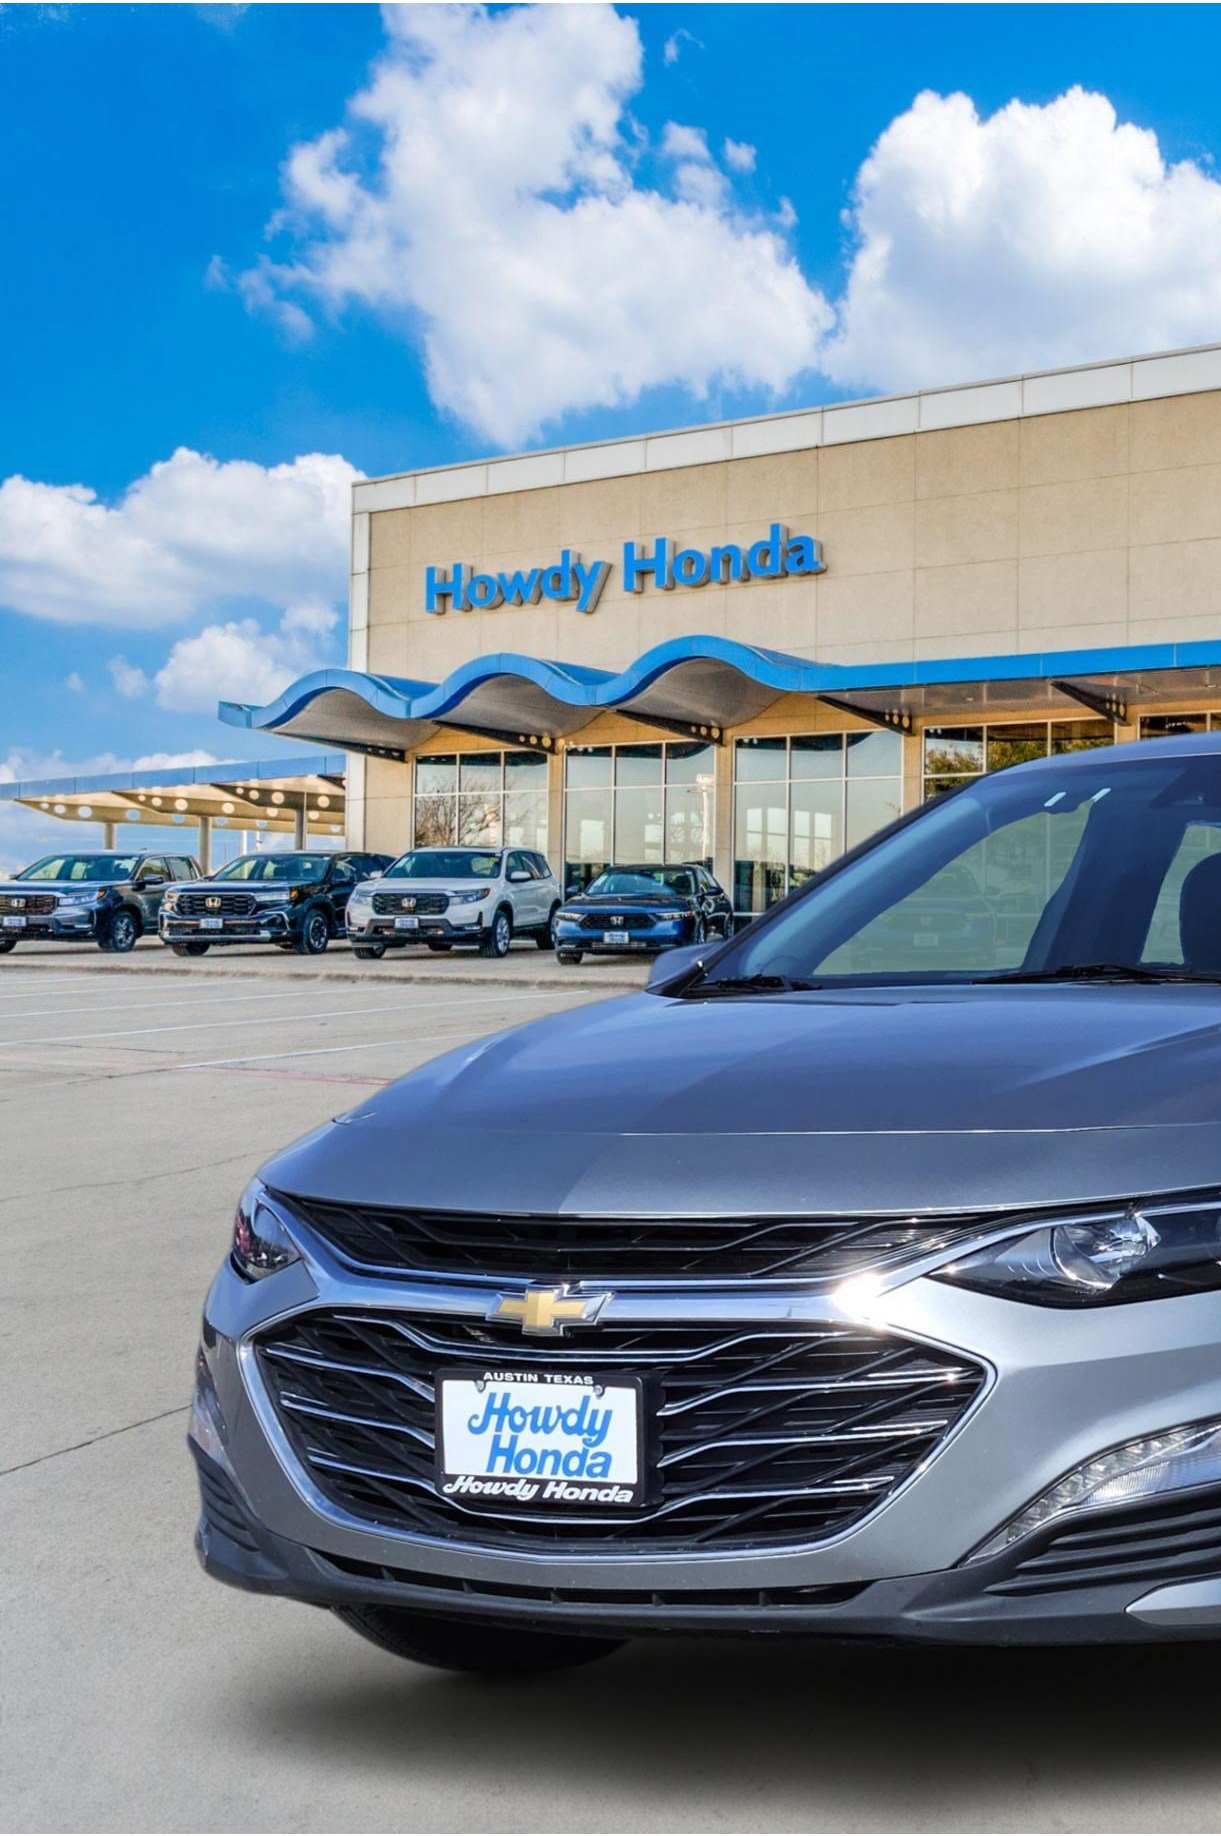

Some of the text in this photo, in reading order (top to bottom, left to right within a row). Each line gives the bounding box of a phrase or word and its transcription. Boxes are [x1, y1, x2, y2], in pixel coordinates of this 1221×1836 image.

[425, 522, 827, 614] Howdy Honda
[483, 1371, 594, 1385] AUSTIN TEXAS
[467, 1392, 613, 1447] Howdy
[486, 1434, 613, 1478] Honda
[442, 1475, 634, 1503] Howdy Honda
